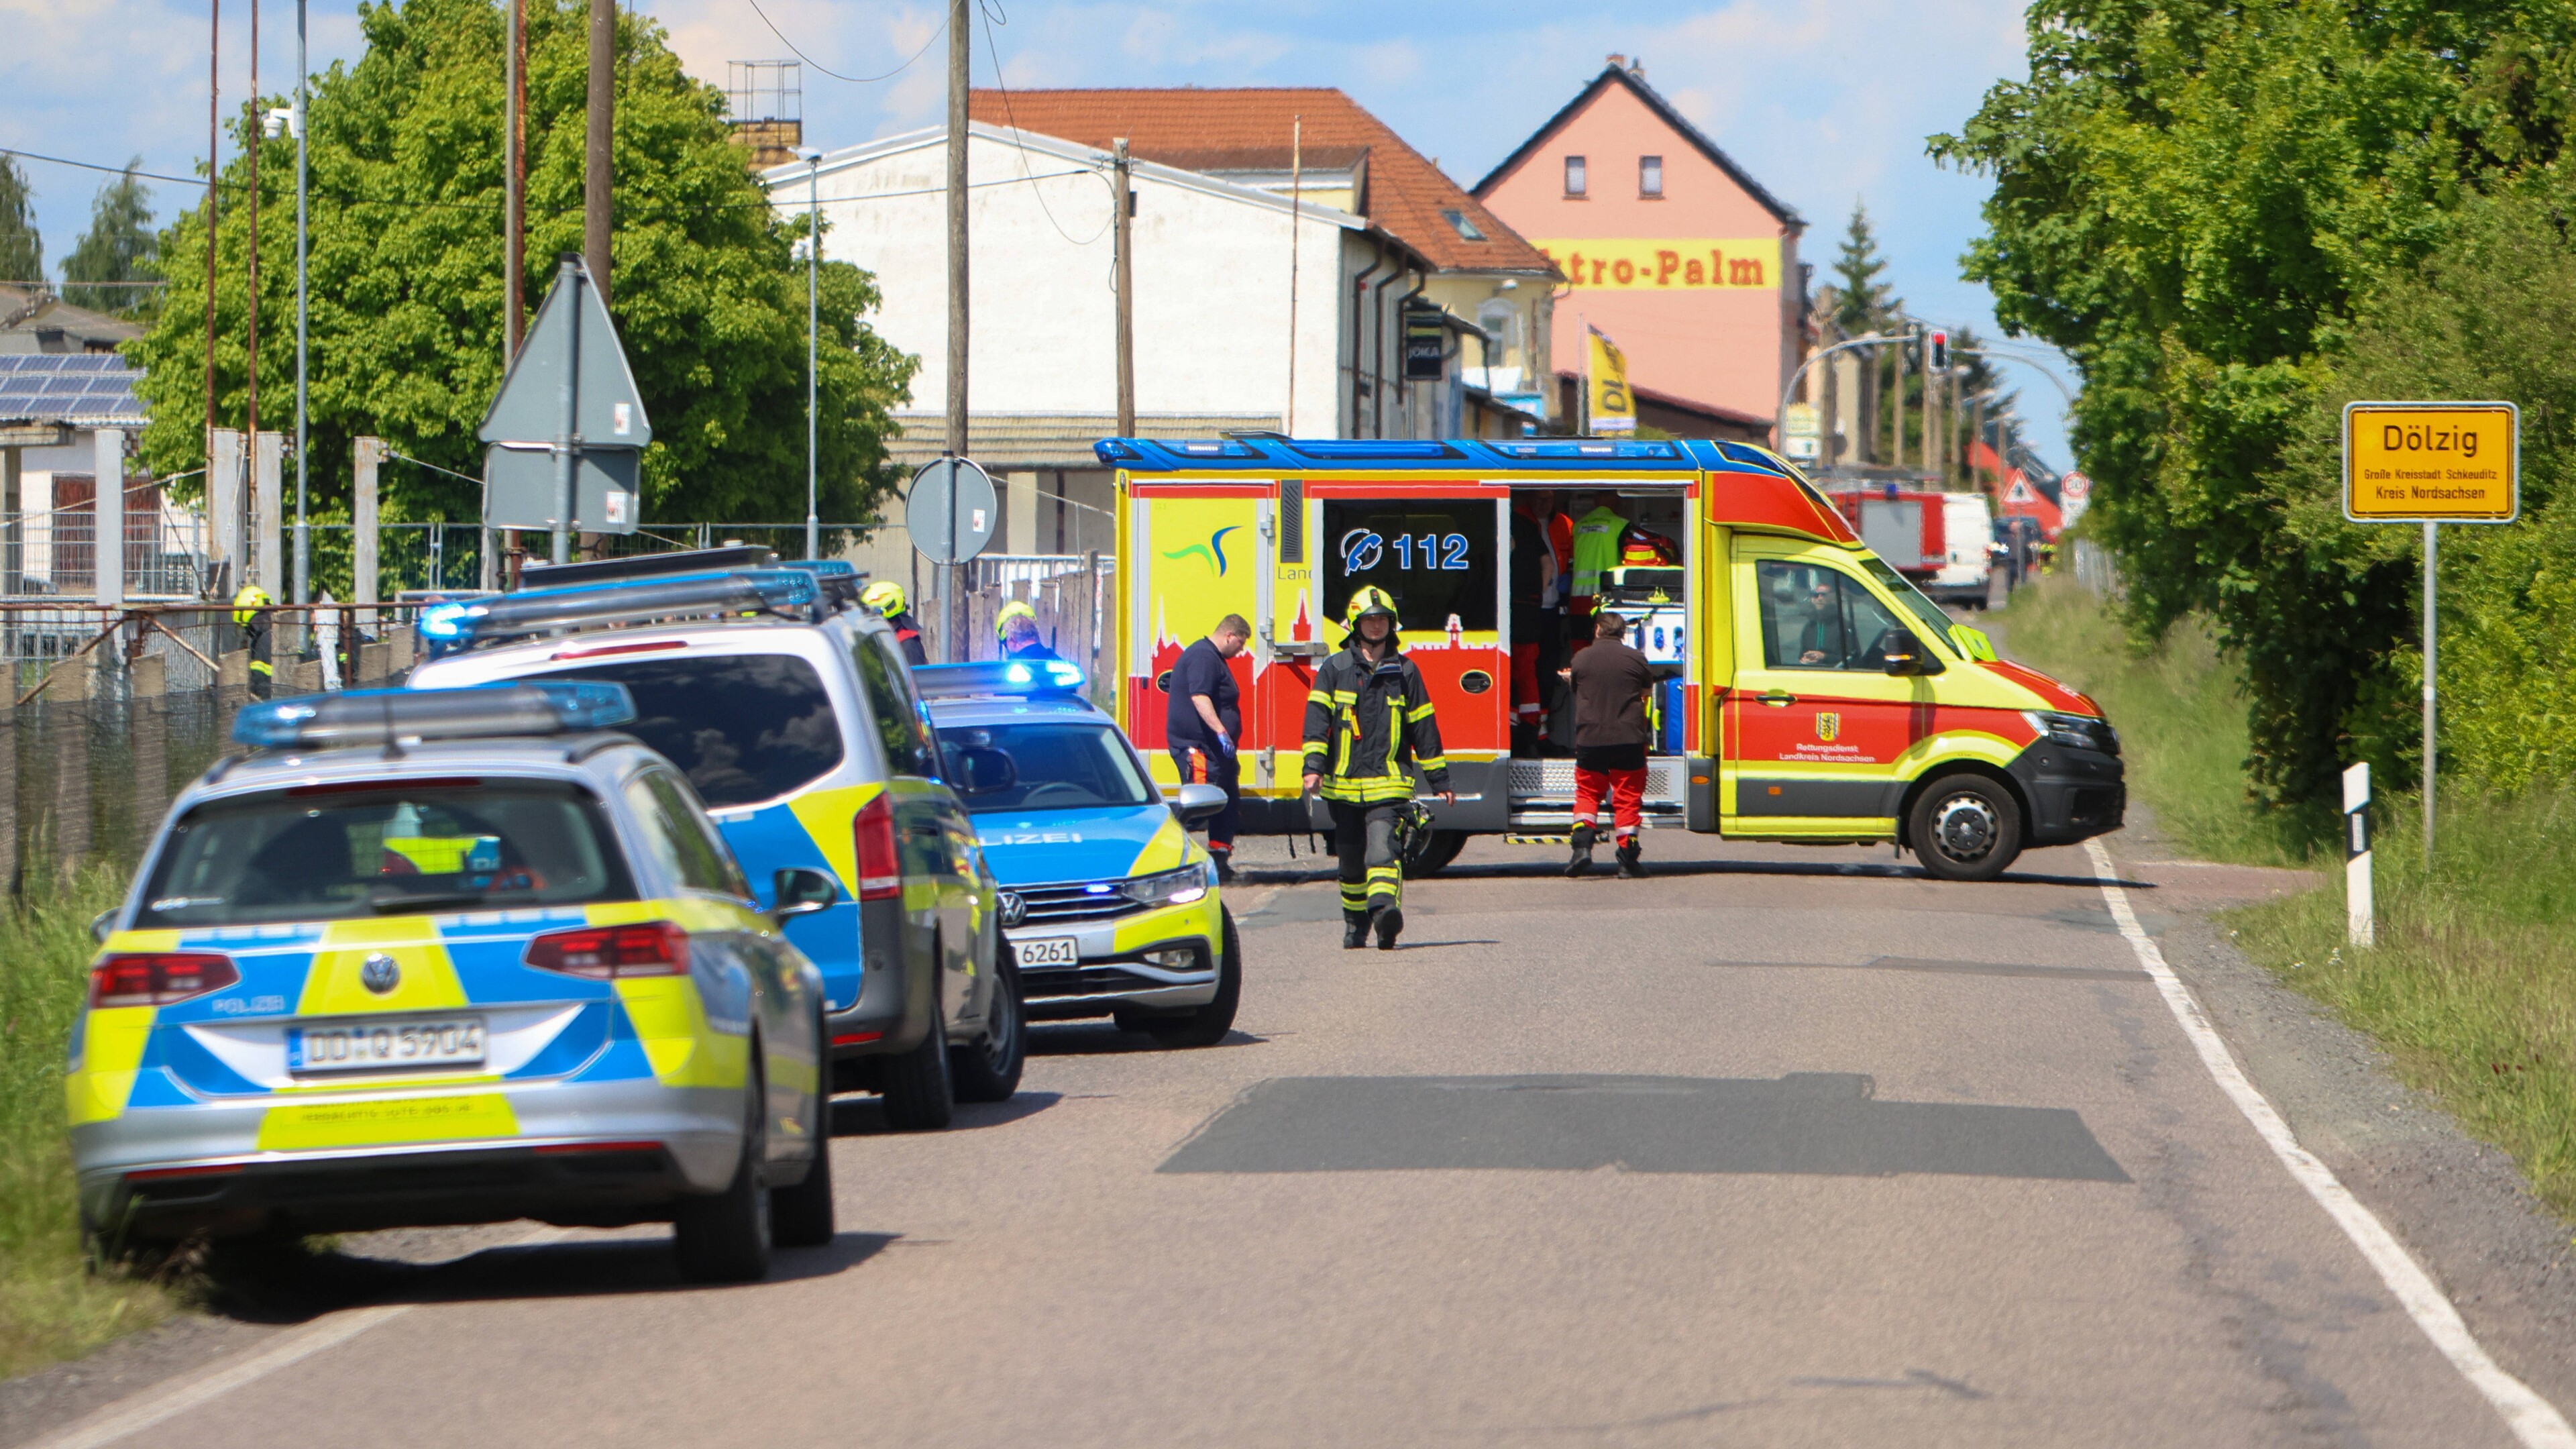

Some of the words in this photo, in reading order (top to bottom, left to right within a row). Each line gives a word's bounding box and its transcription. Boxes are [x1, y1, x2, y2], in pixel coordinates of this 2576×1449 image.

[1539, 248, 1764, 285] tro-Palm
[2383, 424, 2477, 458] Dölzig
[2364, 469, 2391, 480] Große
[2395, 469, 2441, 480] Kreisstadt
[2446, 469, 2498, 480] Schkeuditz
[2376, 485, 2405, 499] Kreis
[2411, 485, 2485, 499] Nordsachsen
[1393, 533, 1469, 570] 112
[1796, 743, 1859, 753] Rettungsdienst
[1779, 752, 1819, 761] Landkreis
[1821, 753, 1875, 763] Nordsachsen
[1023, 941, 1073, 963] 6261
